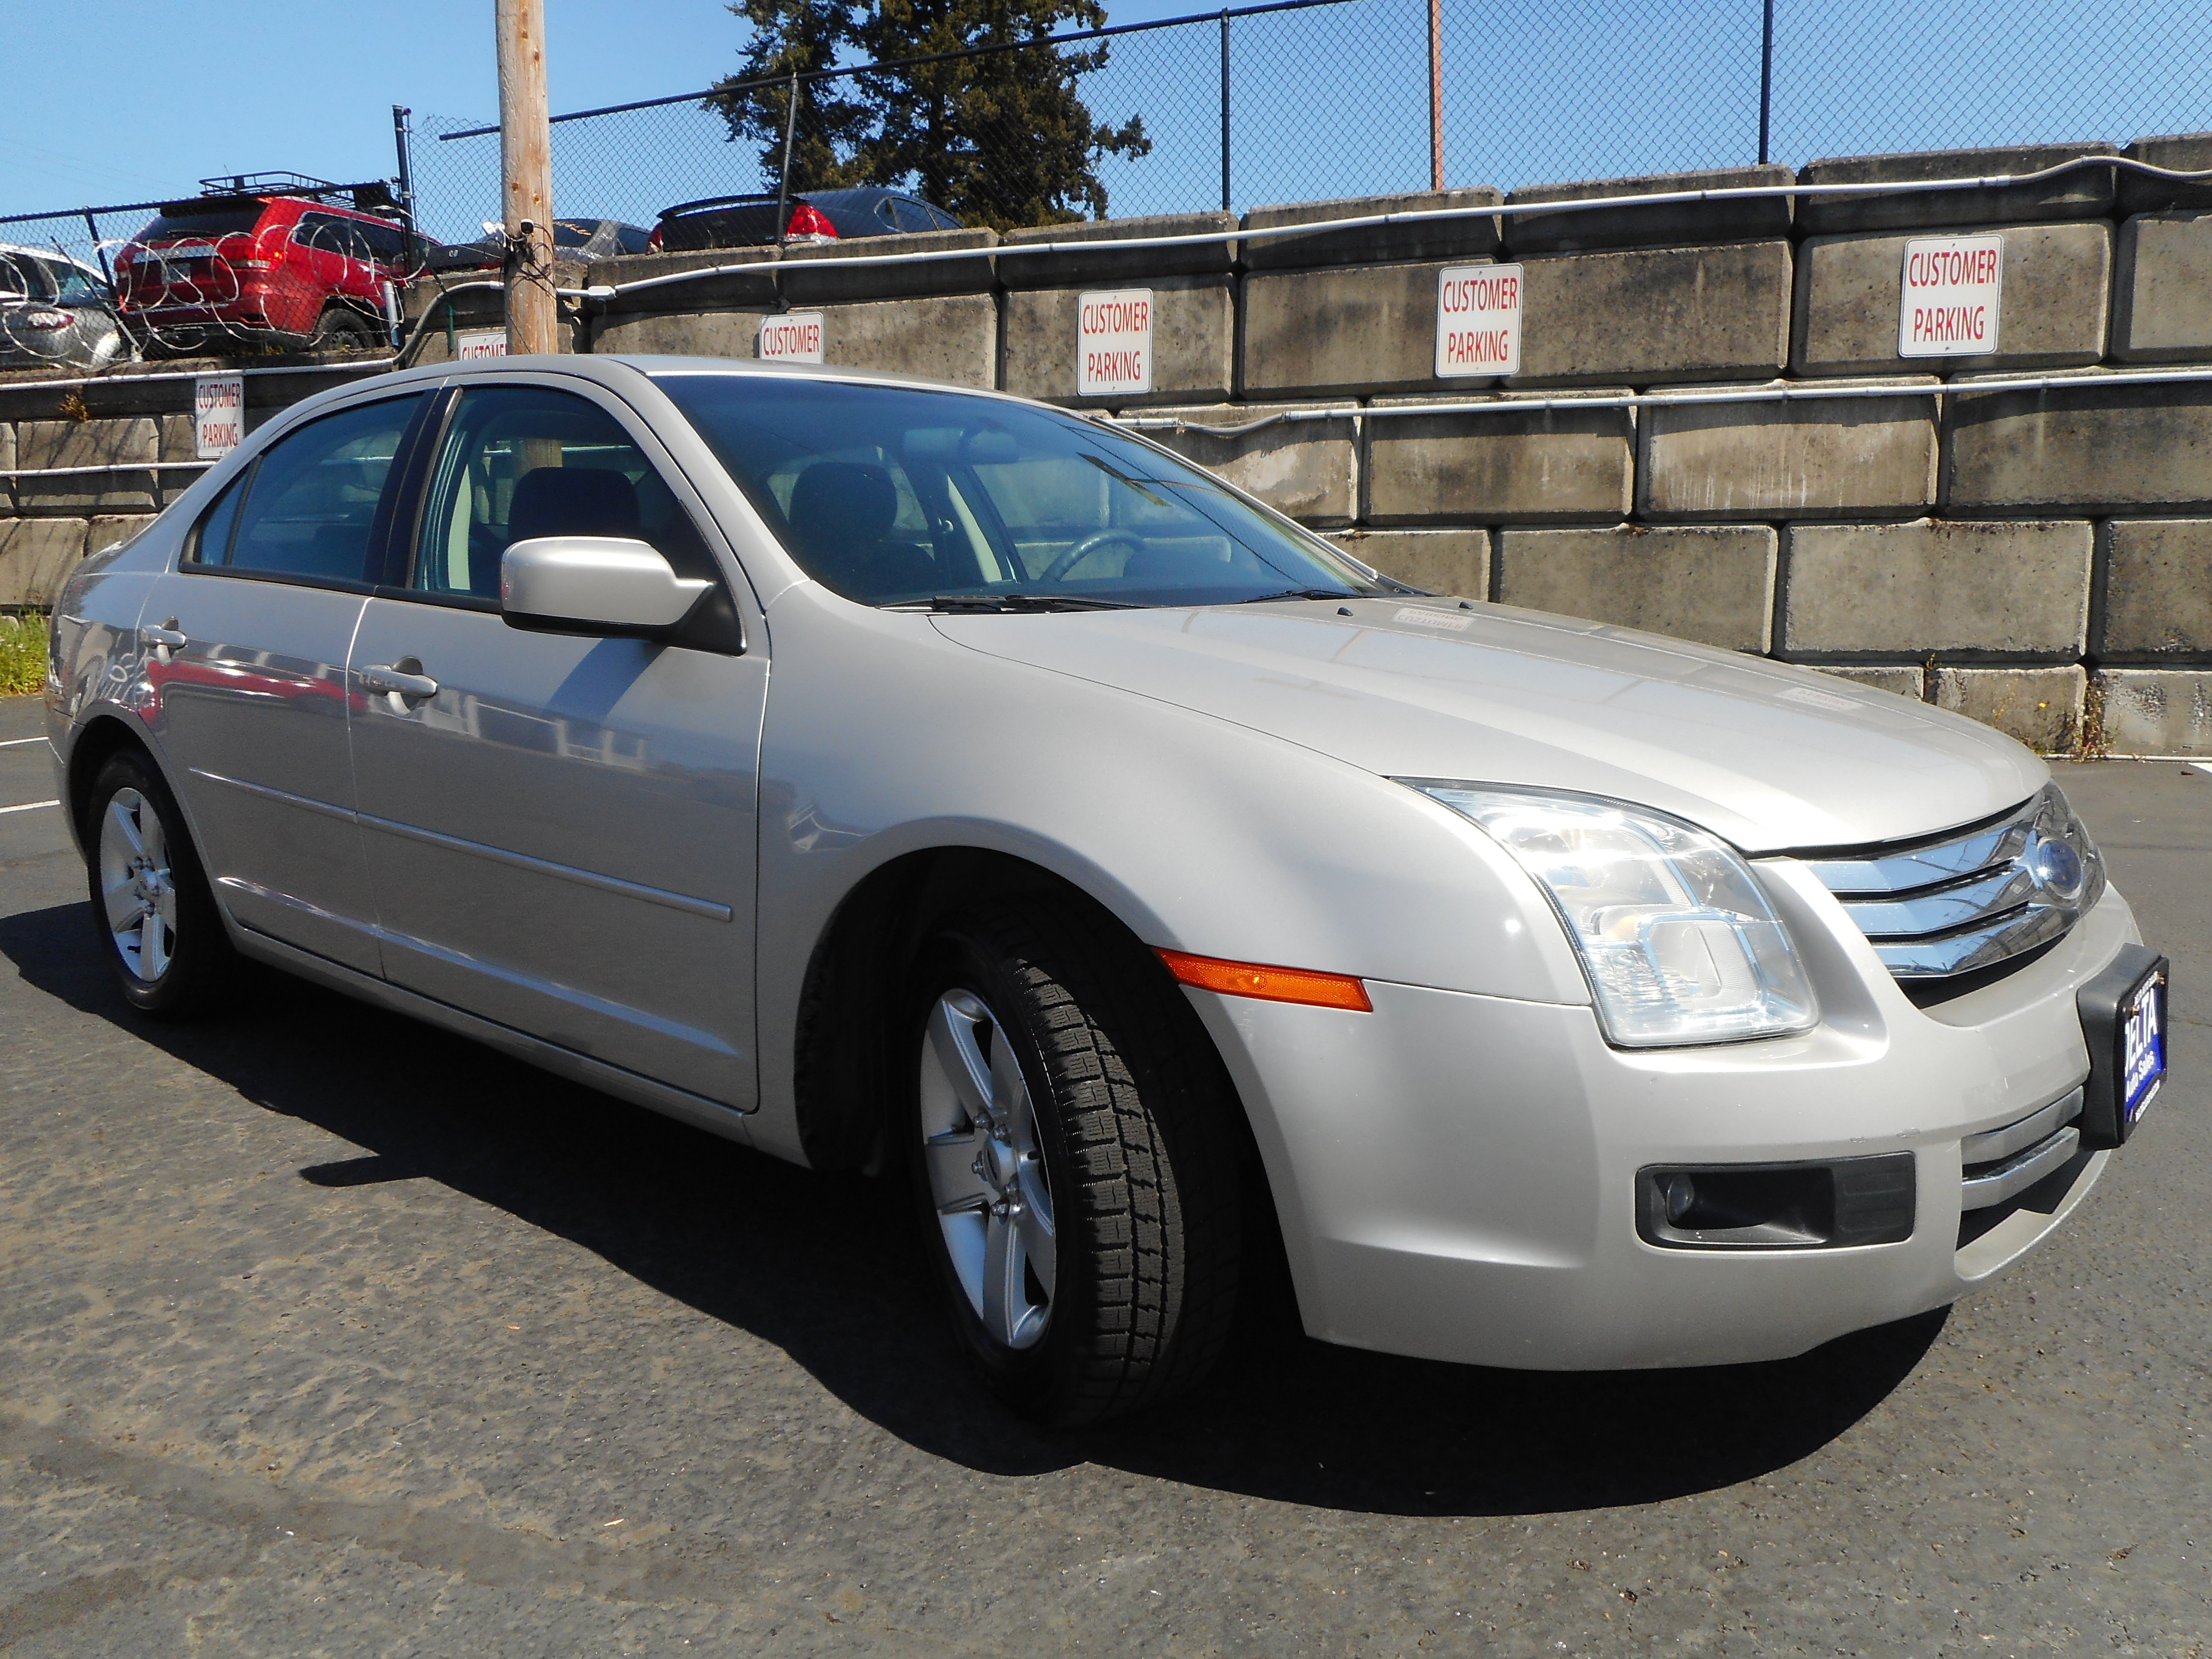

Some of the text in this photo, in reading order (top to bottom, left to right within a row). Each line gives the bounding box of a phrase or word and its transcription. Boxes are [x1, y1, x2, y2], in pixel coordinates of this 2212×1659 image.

[1909, 249, 1996, 287] CUSTOMER
[1443, 277, 1518, 313] CUSTOMER
[1083, 301, 1148, 334] CUSTOMER
[1913, 306, 1984, 342] PARKING
[462, 343, 508, 360] CUSTOME
[763, 324, 819, 356] CUSTOMER
[1448, 330, 1508, 363] PARKING
[1088, 351, 1140, 382] PARKING
[199, 383, 241, 409] CUSTOMER
[203, 423, 238, 447] PARKING
